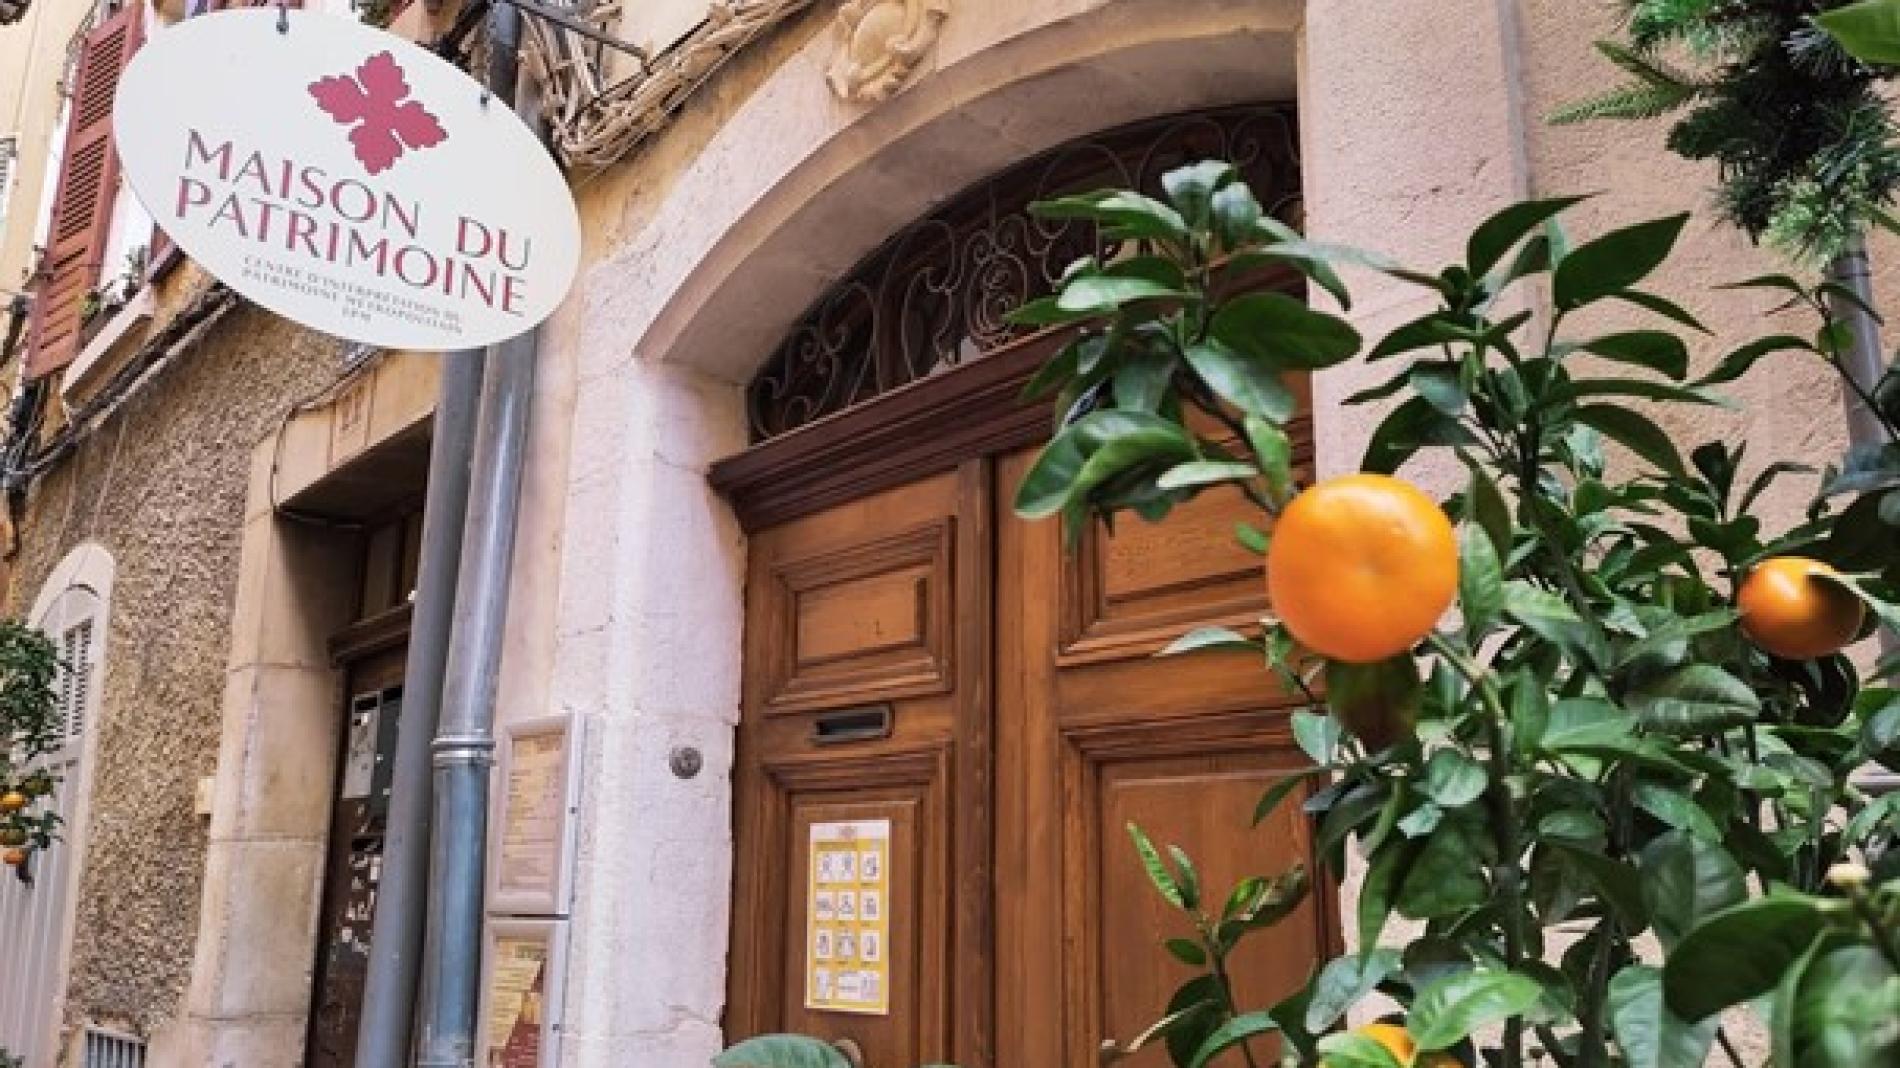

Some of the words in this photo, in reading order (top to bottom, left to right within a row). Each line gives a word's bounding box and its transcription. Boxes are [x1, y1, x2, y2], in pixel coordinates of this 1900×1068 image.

[176, 175, 527, 318] PATRIMOINE
[185, 128, 420, 239] MAISON
[456, 216, 531, 271] DU
